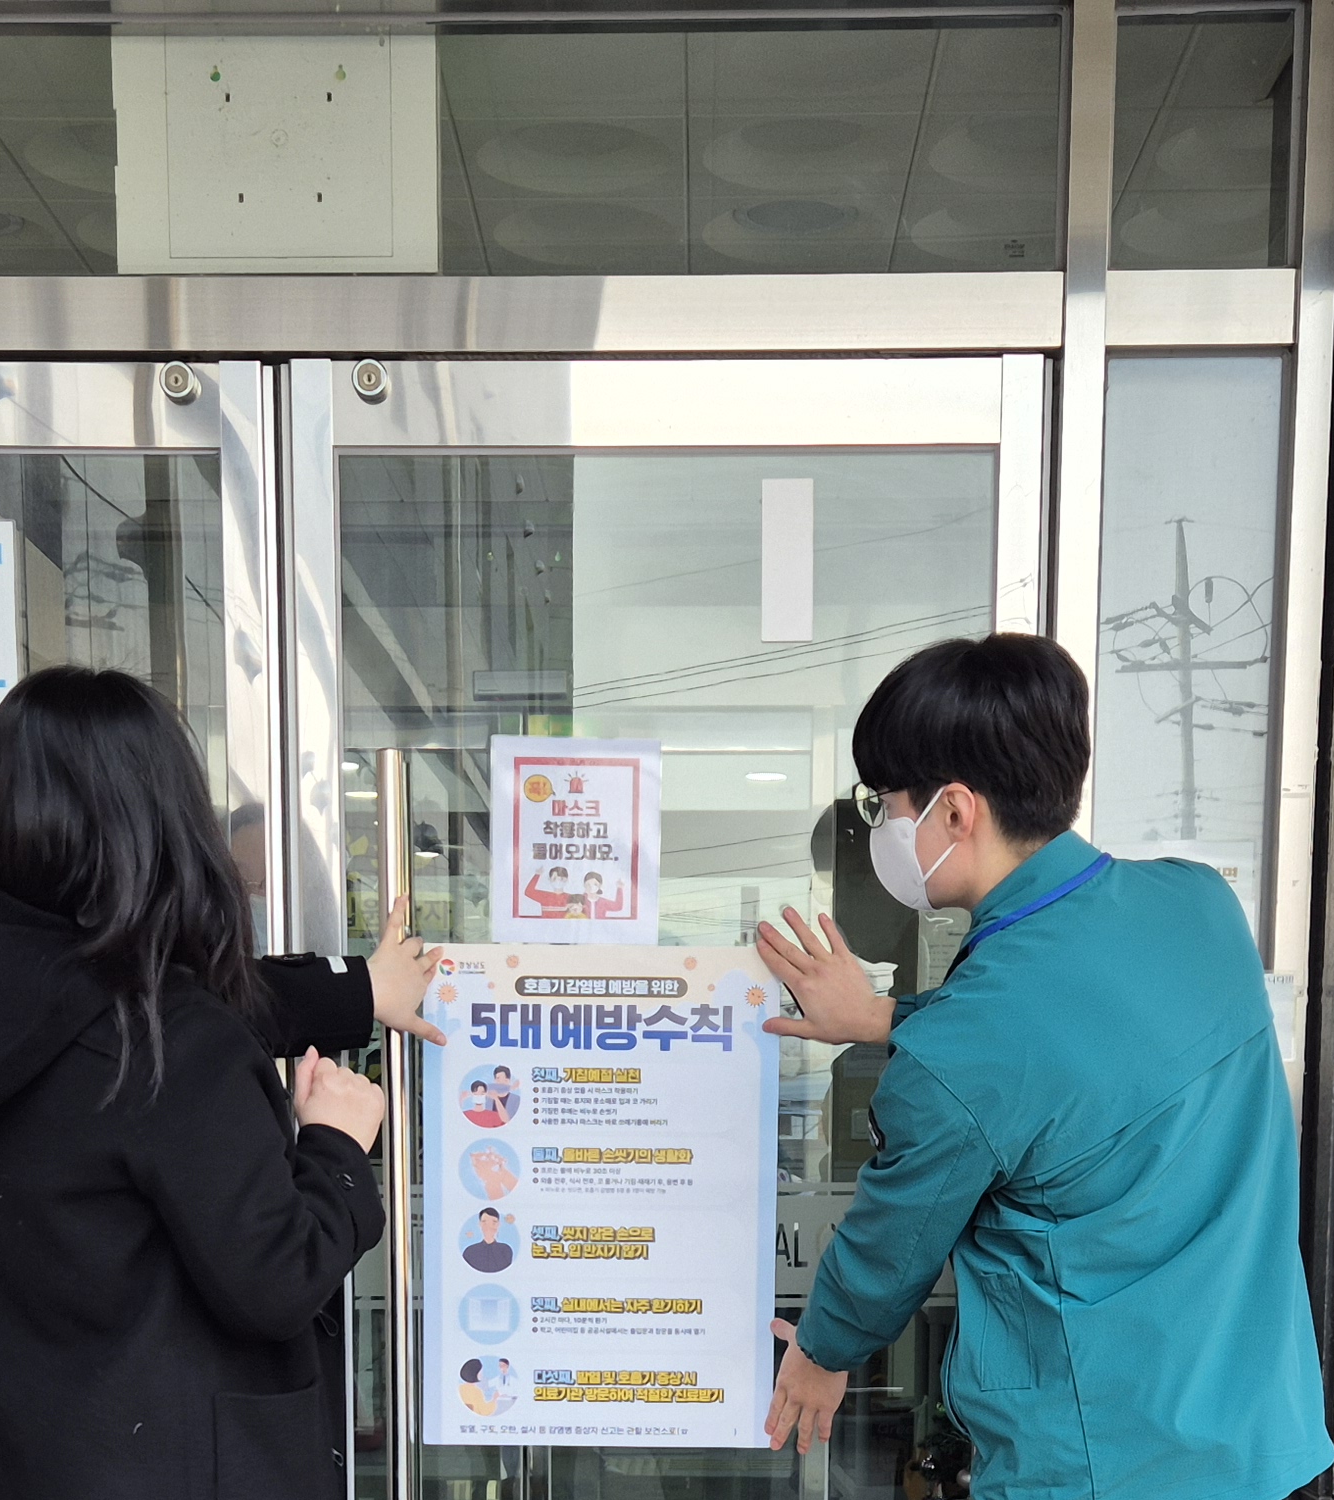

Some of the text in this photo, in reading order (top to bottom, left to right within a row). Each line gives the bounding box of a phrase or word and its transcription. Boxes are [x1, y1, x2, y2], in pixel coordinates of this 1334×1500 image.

[552, 800, 601, 817] 마스크
[543, 821, 608, 839] 착용하고
[532, 843, 619, 861] 들어오세요.
[524, 978, 679, 995] 호흡기 감염병 예방을 위한
[470, 1003, 733, 1051] 5대 예방수칙
[563, 1068, 614, 1083] 기침예절
[614, 1068, 641, 1083] 실천
[602, 1148, 652, 1164] 손씻기의
[562, 1226, 588, 1242] 씻지
[589, 1226, 616, 1242] 않은
[617, 1227, 655, 1242] 손으로
[568, 1243, 582, 1259] 입
[583, 1244, 620, 1260] 만지기
[622, 1244, 649, 1260] 않기
[561, 1298, 624, 1313] 실내에서는
[624, 1298, 650, 1314] 자주
[651, 1298, 703, 1314] 환기하기
[576, 1370, 602, 1385] 발열
[603, 1370, 616, 1385] 및
[617, 1370, 656, 1386] 호흡기
[657, 1371, 683, 1385] 증상
[683, 1371, 698, 1386] 시
[533, 1387, 725, 1403] 의료기관 방문하여 적절한 진료받기
